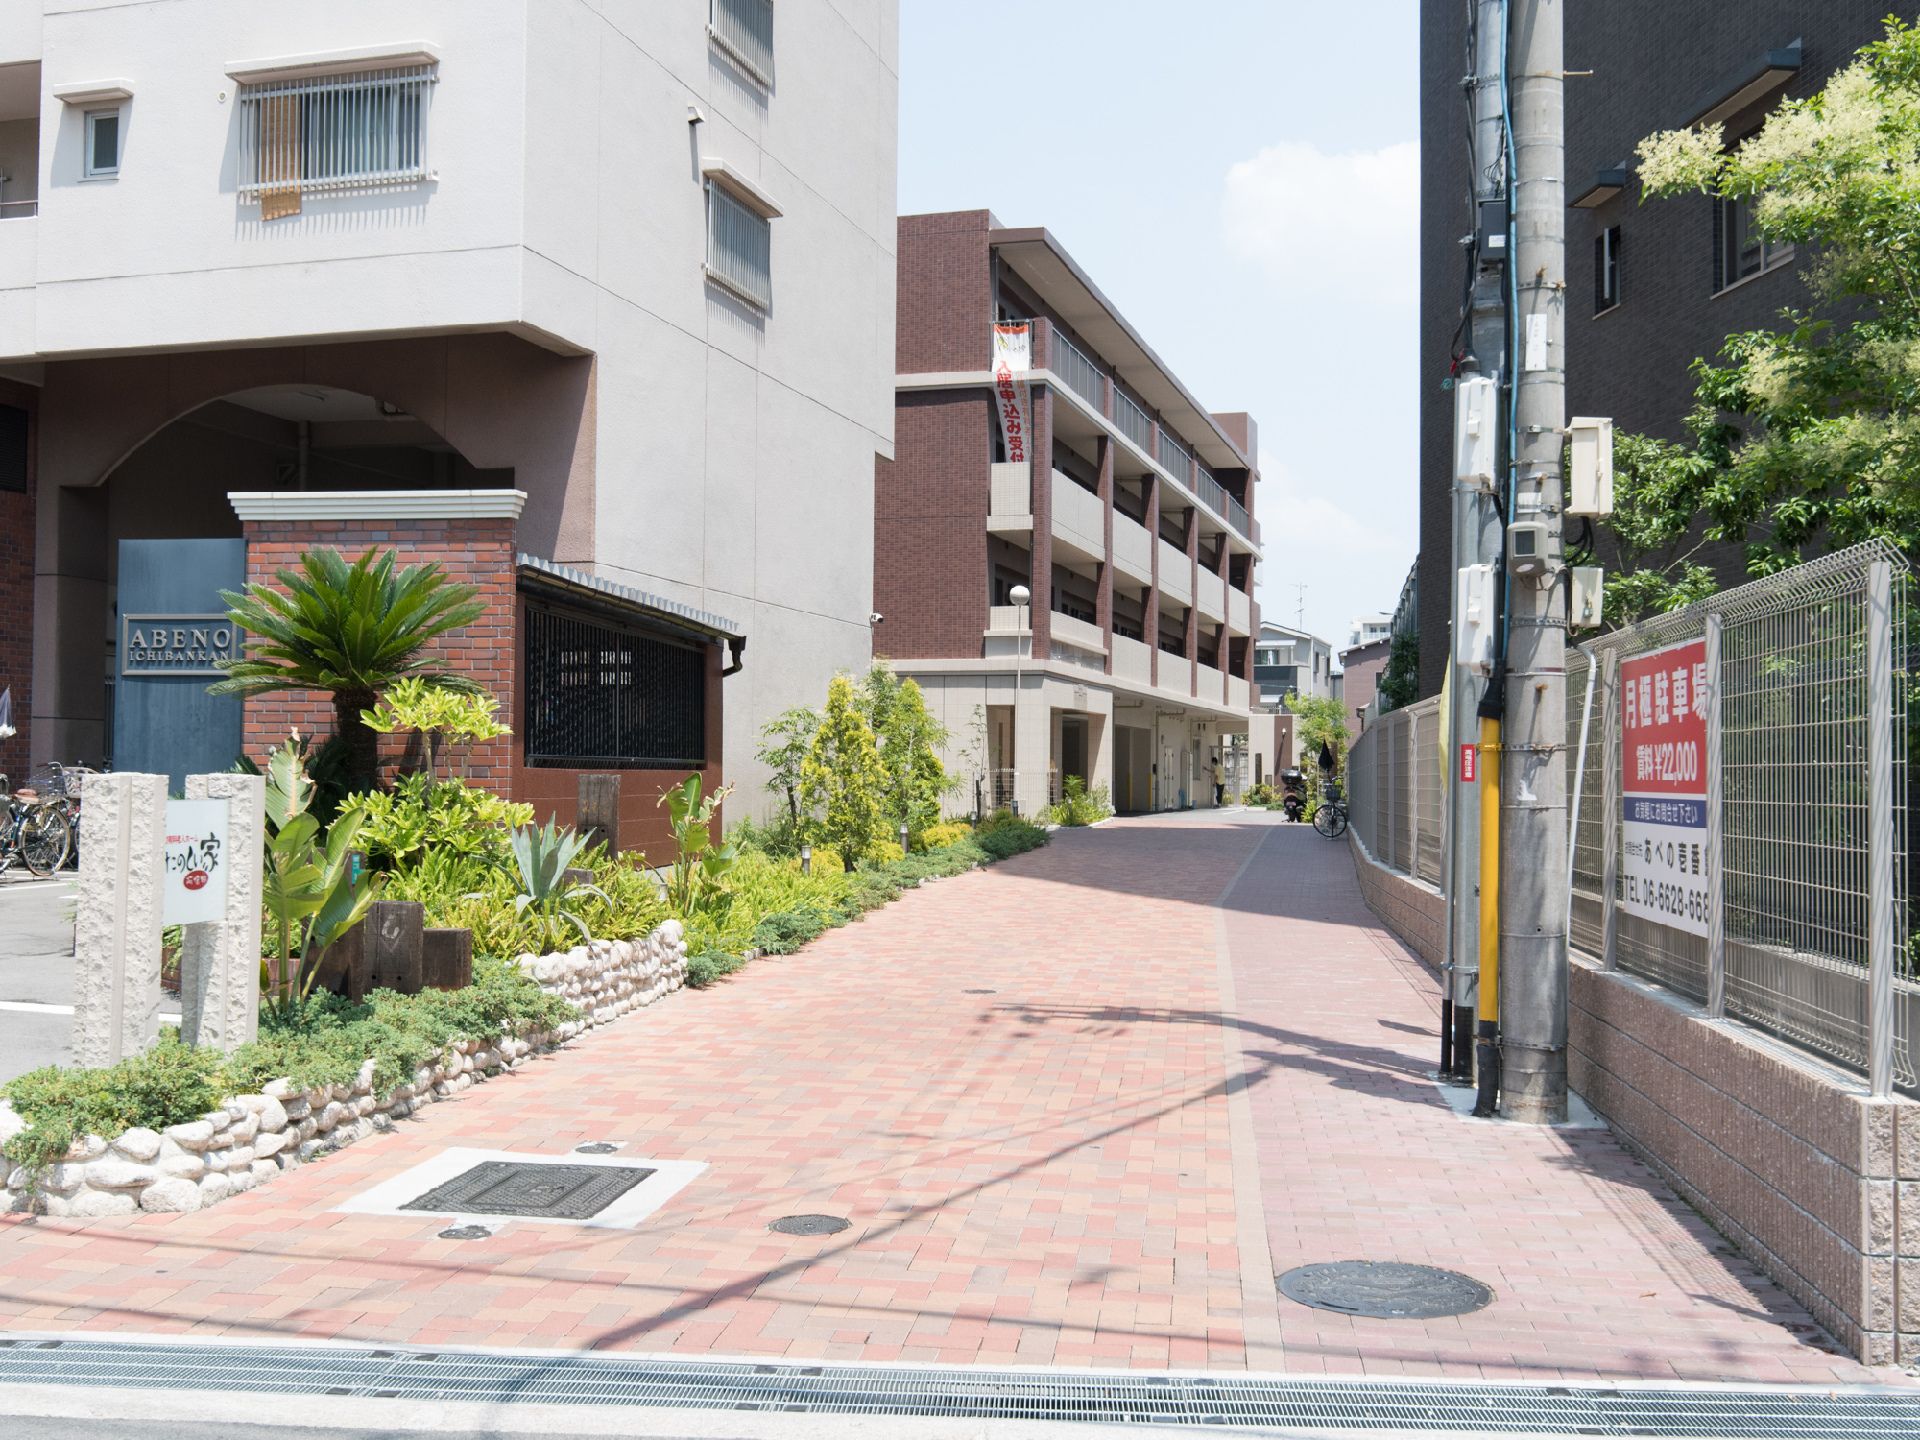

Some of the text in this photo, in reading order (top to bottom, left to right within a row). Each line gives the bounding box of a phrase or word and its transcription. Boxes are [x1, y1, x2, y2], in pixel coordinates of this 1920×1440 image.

[128, 628, 231, 649] ABENO
[129, 650, 230, 662] ICHIBANKAN
[1625, 661, 1708, 729] 月極駐車場
[1643, 837, 1709, 877] あべの壱番
[1623, 874, 1641, 904] TEL
